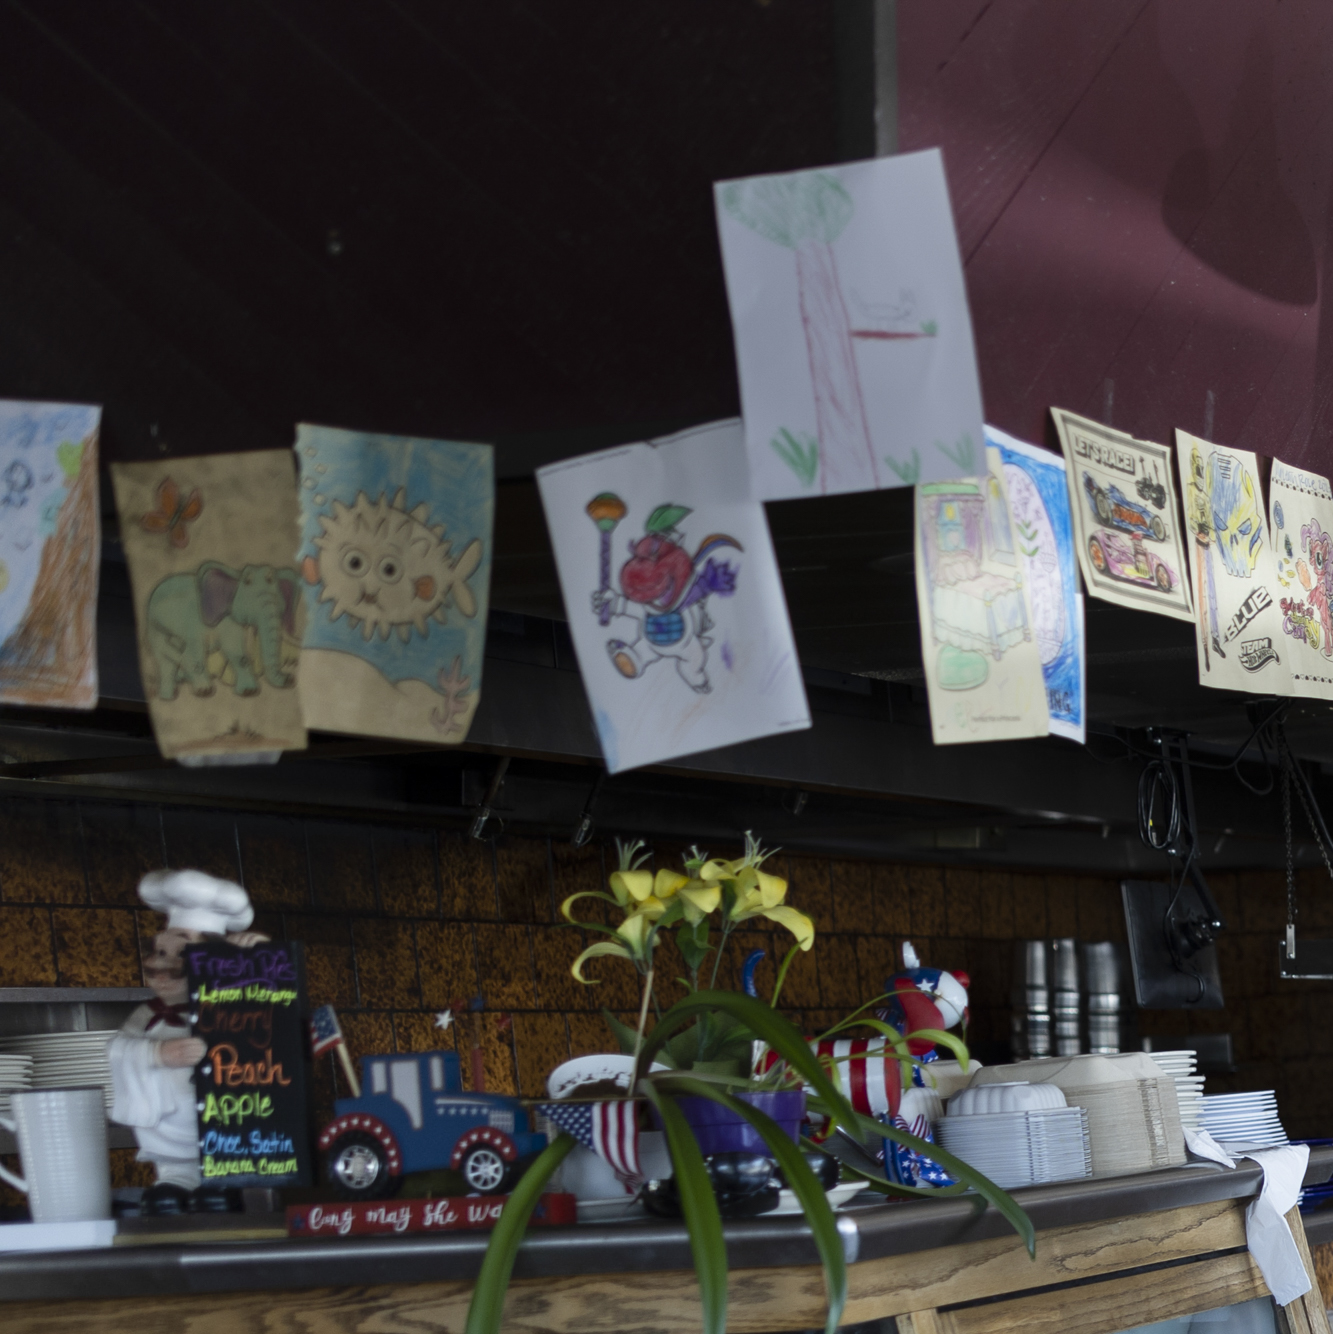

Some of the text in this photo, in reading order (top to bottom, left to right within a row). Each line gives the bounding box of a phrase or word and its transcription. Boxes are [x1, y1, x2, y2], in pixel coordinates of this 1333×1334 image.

[1074, 433, 1136, 476] LET'S RACE!
[1223, 586, 1274, 644] BLUE
[1241, 637, 1272, 656] TEAM
[189, 951, 254, 977] Fresh
[199, 983, 244, 1005] Lemon
[200, 1001, 274, 1049] Cherry
[209, 1043, 292, 1087] Peach
[249, 1128, 295, 1155] Satin
[203, 1154, 256, 1178] Banana
[366, 1203, 412, 1232] may
